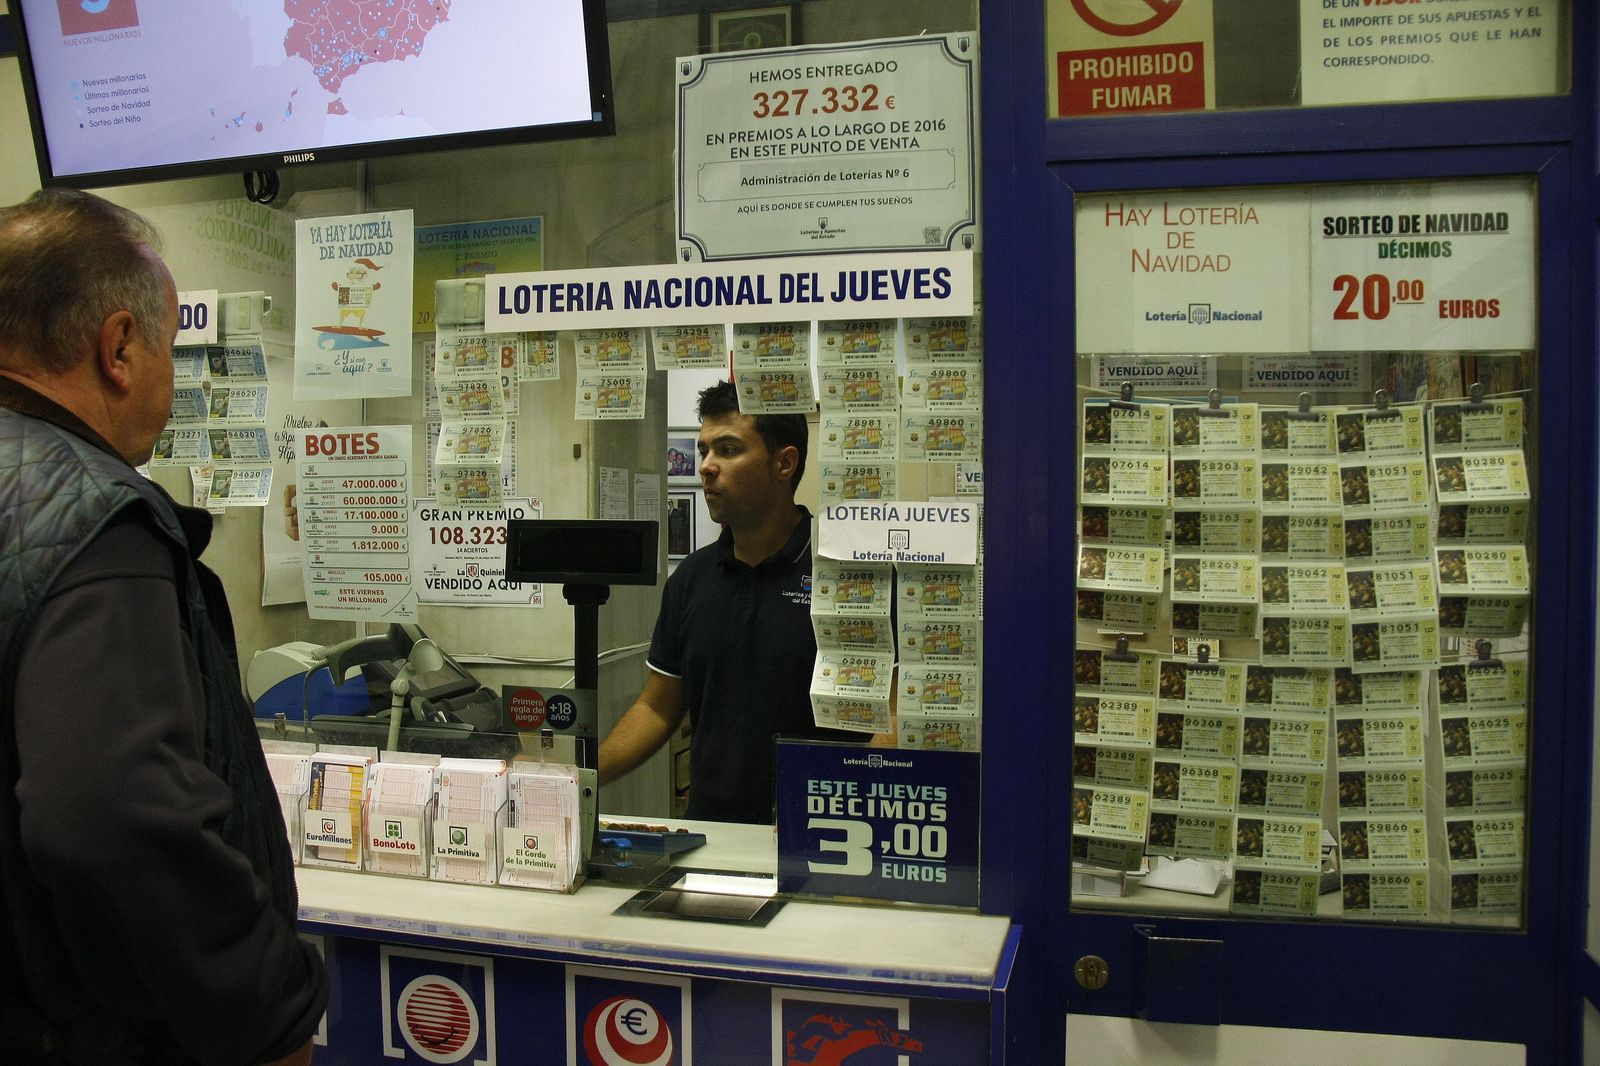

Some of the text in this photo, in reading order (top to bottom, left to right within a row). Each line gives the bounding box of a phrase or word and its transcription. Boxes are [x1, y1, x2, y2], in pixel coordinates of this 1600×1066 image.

[1323, 7, 1542, 28] EL IMPORTE DE SUS APUESTAS Y EL
[63, 30, 142, 47] NUEVOS MILLONARIOS
[1324, 28, 1541, 48] DE LOS PREMIOS QUE LE HAN
[1069, 51, 1194, 80] PROHIBIDO
[1323, 54, 1434, 68] CORRESPONDIDO.
[750, 61, 897, 83] HEMOS ENTREGADO
[82, 73, 146, 88] Nuevos millonarios
[111, 86, 149, 98] millonarios
[1091, 85, 1172, 109] FUMAR
[87, 99, 150, 114] Sorteo de Navidad
[753, 84, 895, 118] 327.332 €
[89, 115, 141, 128] Sorteo del Niño
[706, 119, 946, 146] EN PREMIOS A LO LARGO DE 2016
[730, 137, 919, 159] EN ESTE PUNTO DE VENTA
[284, 153, 314, 163] PHILIPS
[741, 168, 909, 186] Administración de Loterías Nº 6
[737, 203, 758, 213] AQUÍ
[771, 201, 802, 210] DONDE
[816, 199, 858, 208] CUMPLEN
[877, 195, 912, 205] SUEÑOS
[310, 215, 393, 244] YA HAY LOTERÍA
[1323, 212, 1509, 236] SORTEO DE NAVIDAD
[473, 224, 536, 239] NACIONAL
[1166, 232, 1194, 249] DE
[320, 242, 393, 260] DE NAVIDAD
[1378, 240, 1452, 258] DÉCIMOS
[499, 267, 952, 314] LOTERIA NACIONAL DEL JUEVES
[1333, 273, 1500, 321] 20,00 EUROS
[1145, 310, 1262, 322] Lotería Nacional
[676, 328, 709, 336] 94294
[1107, 366, 1164, 376] VENDIDO
[1167, 363, 1199, 375] AQUÍ
[1257, 371, 1314, 381] VENDIDO
[305, 433, 380, 456] BOTES
[1111, 461, 1149, 469] 07614
[1202, 462, 1239, 470] 58263
[1465, 457, 1505, 466] 80280
[1290, 466, 1327, 475] 29042
[1369, 466, 1407, 476] 81051
[342, 479, 397, 489] 47.000.000
[343, 496, 398, 505] 60.000.000
[344, 510, 398, 520] 17.100.000
[420, 508, 524, 521] GRAN PREMIO
[827, 503, 970, 523] LOTERÍA JUEVES
[371, 525, 399, 534] 9.000
[430, 526, 508, 545] 108.323
[352, 541, 399, 550] 1.812.000
[853, 551, 944, 562] Lotería Nacional
[364, 573, 402, 582] 105.000
[425, 579, 482, 590] VENDIDO
[512, 698, 543, 706] Primera
[550, 702, 571, 715] +18
[515, 713, 539, 722] juego:
[1185, 718, 1222, 728] 96368
[1470, 719, 1509, 728] 64625
[1272, 722, 1309, 731] 32367
[1365, 721, 1404, 729] 59866
[883, 759, 912, 768] Nacional
[808, 780, 947, 802] ESTE JUEVES
[1095, 794, 1131, 803] 62389
[807, 793, 947, 822] DÉCIMOS
[306, 834, 352, 845] EuroMillones
[373, 838, 415, 850] BonoLoto
[447, 847, 480, 858] Primitiva
[807, 818, 948, 876] 3,00
[505, 856, 515, 865] de
[524, 849, 546, 859] Gordo
[882, 863, 946, 883] EUROS
